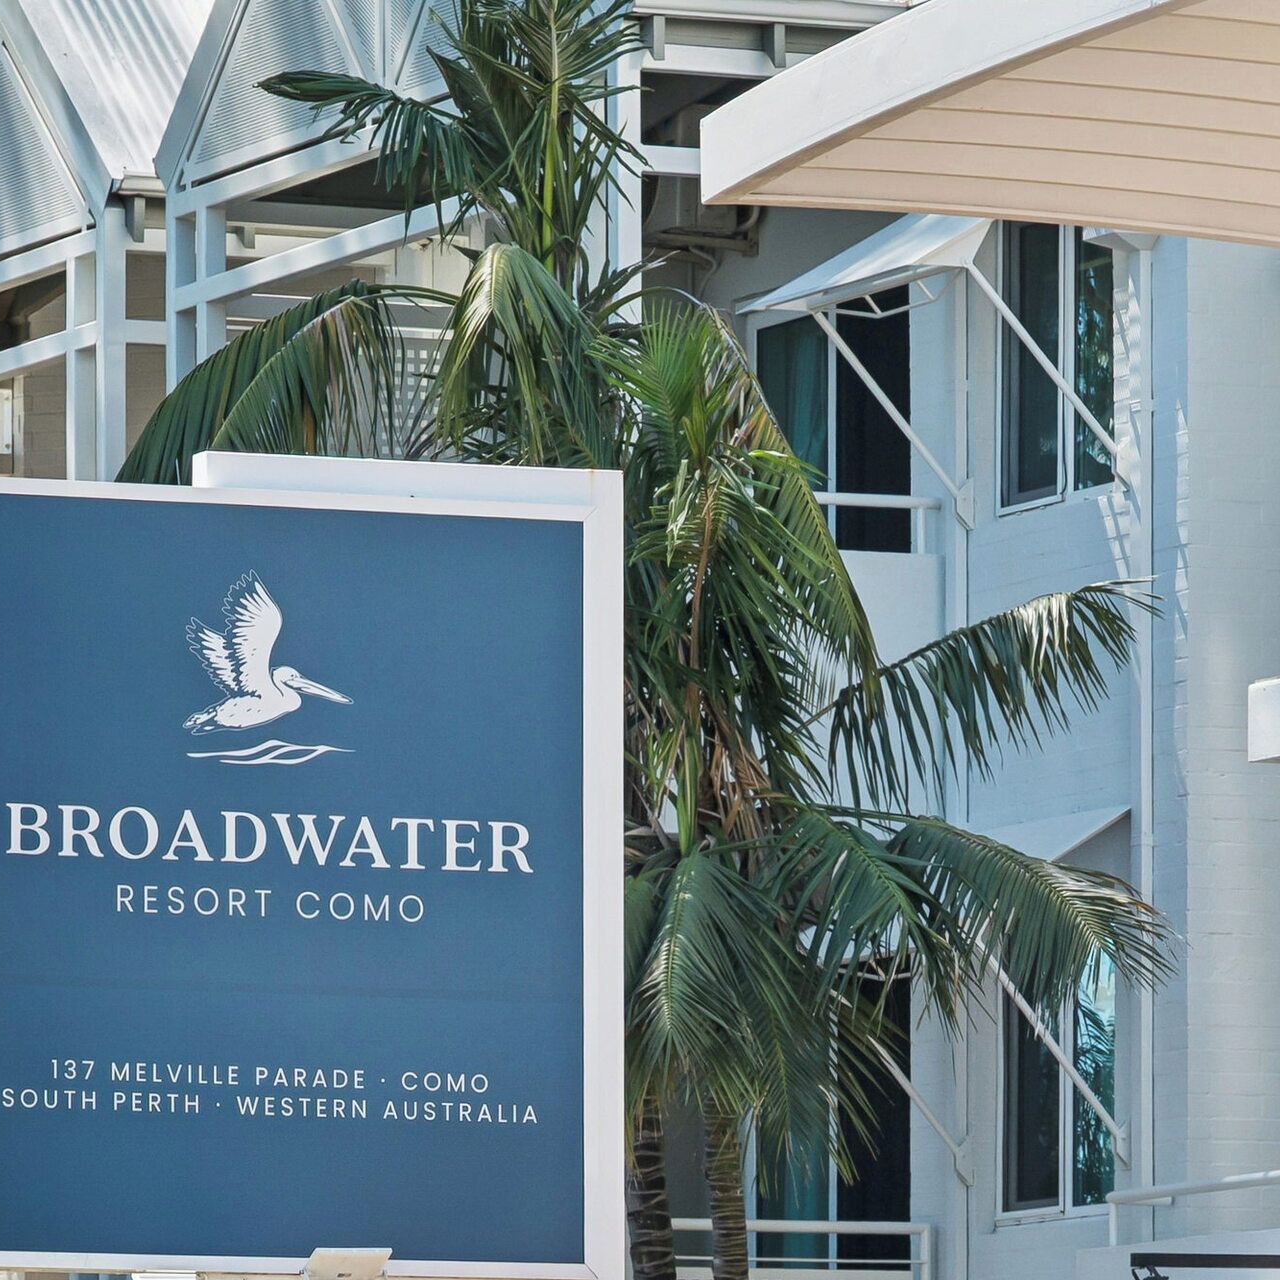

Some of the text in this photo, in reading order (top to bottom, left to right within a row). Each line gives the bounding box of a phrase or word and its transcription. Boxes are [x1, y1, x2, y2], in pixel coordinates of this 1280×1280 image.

[6, 802, 534, 873] BROADWATER
[116, 884, 424, 923] RESORT COMO
[51, 1059, 489, 1093] 137 MELVILLE PARADE COMO
[2, 1088, 538, 1124] SOUTH PERTH WESTERN AUSTRALIA
